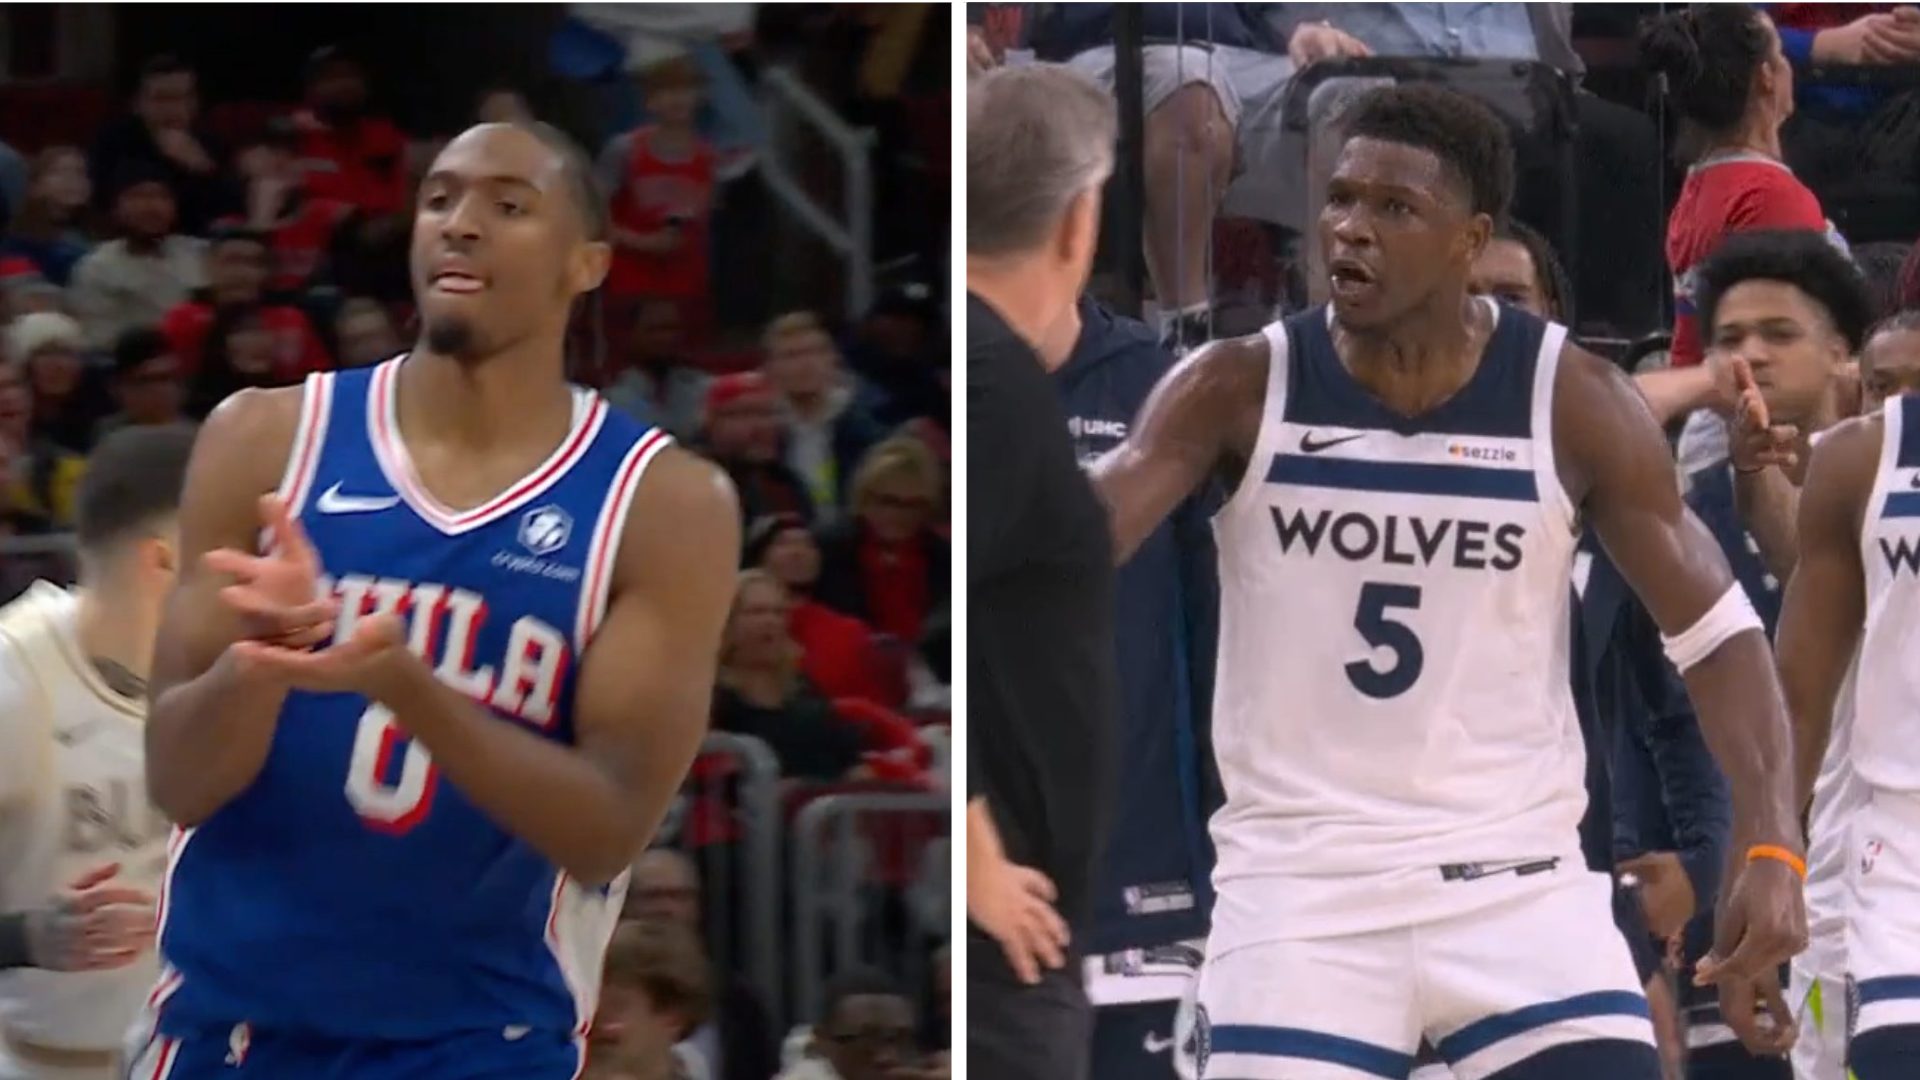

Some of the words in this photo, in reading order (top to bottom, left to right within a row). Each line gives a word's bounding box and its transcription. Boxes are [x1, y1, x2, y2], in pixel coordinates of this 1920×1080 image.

[1083, 419, 1127, 437] UHC
[1461, 445, 1516, 462] sezzle
[1270, 505, 1525, 571] WOLVES
[314, 571, 570, 730] HILA
[1344, 582, 1424, 699] 5
[344, 700, 438, 836] 0
